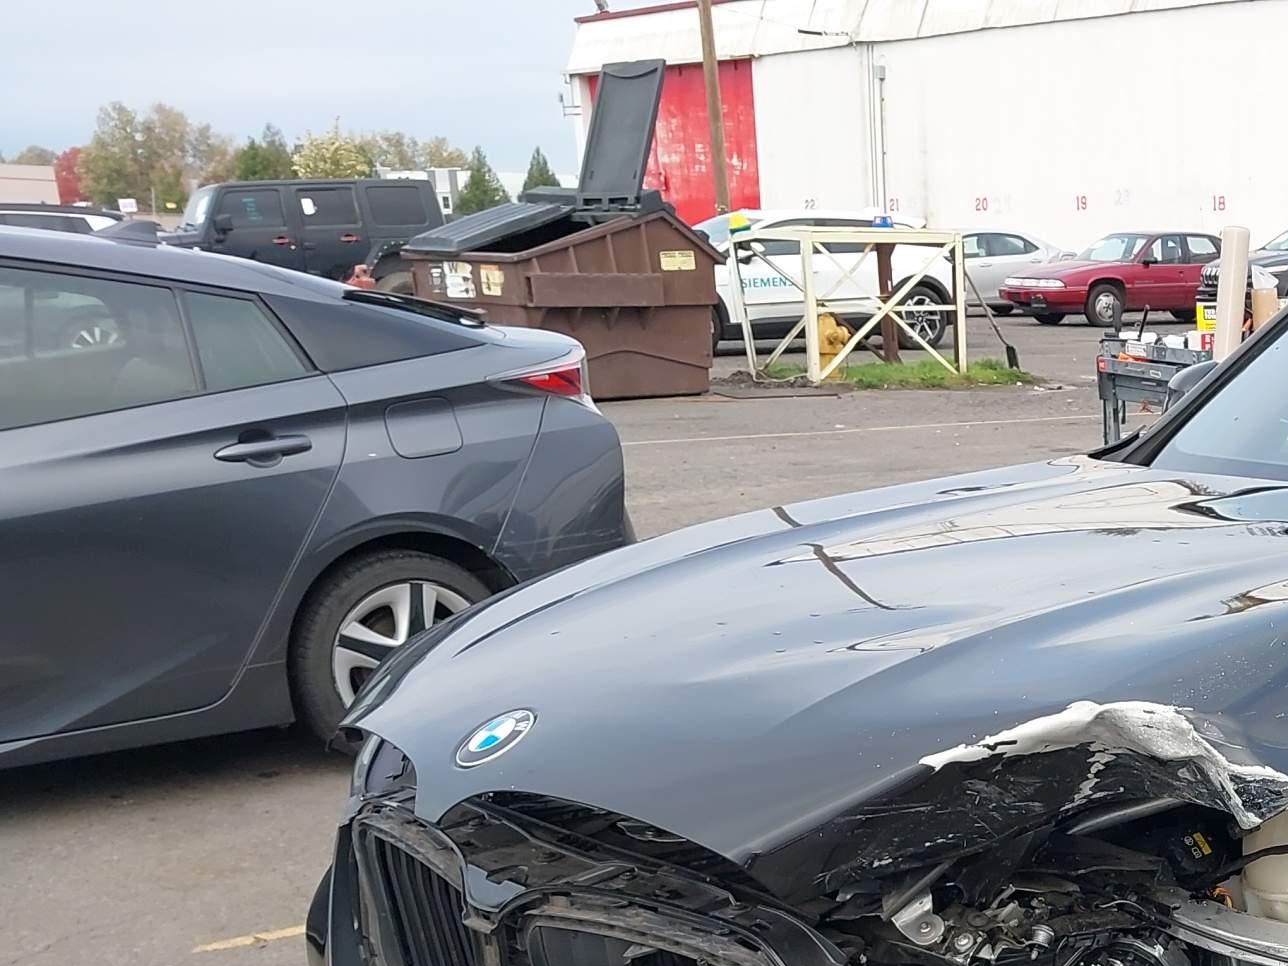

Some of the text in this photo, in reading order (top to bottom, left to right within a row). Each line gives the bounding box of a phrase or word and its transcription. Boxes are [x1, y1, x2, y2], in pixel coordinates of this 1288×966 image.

[889, 198, 899, 212] 21
[975, 197, 988, 211] 20
[1076, 195, 1087, 211] 19
[1213, 195, 1225, 211] 18
